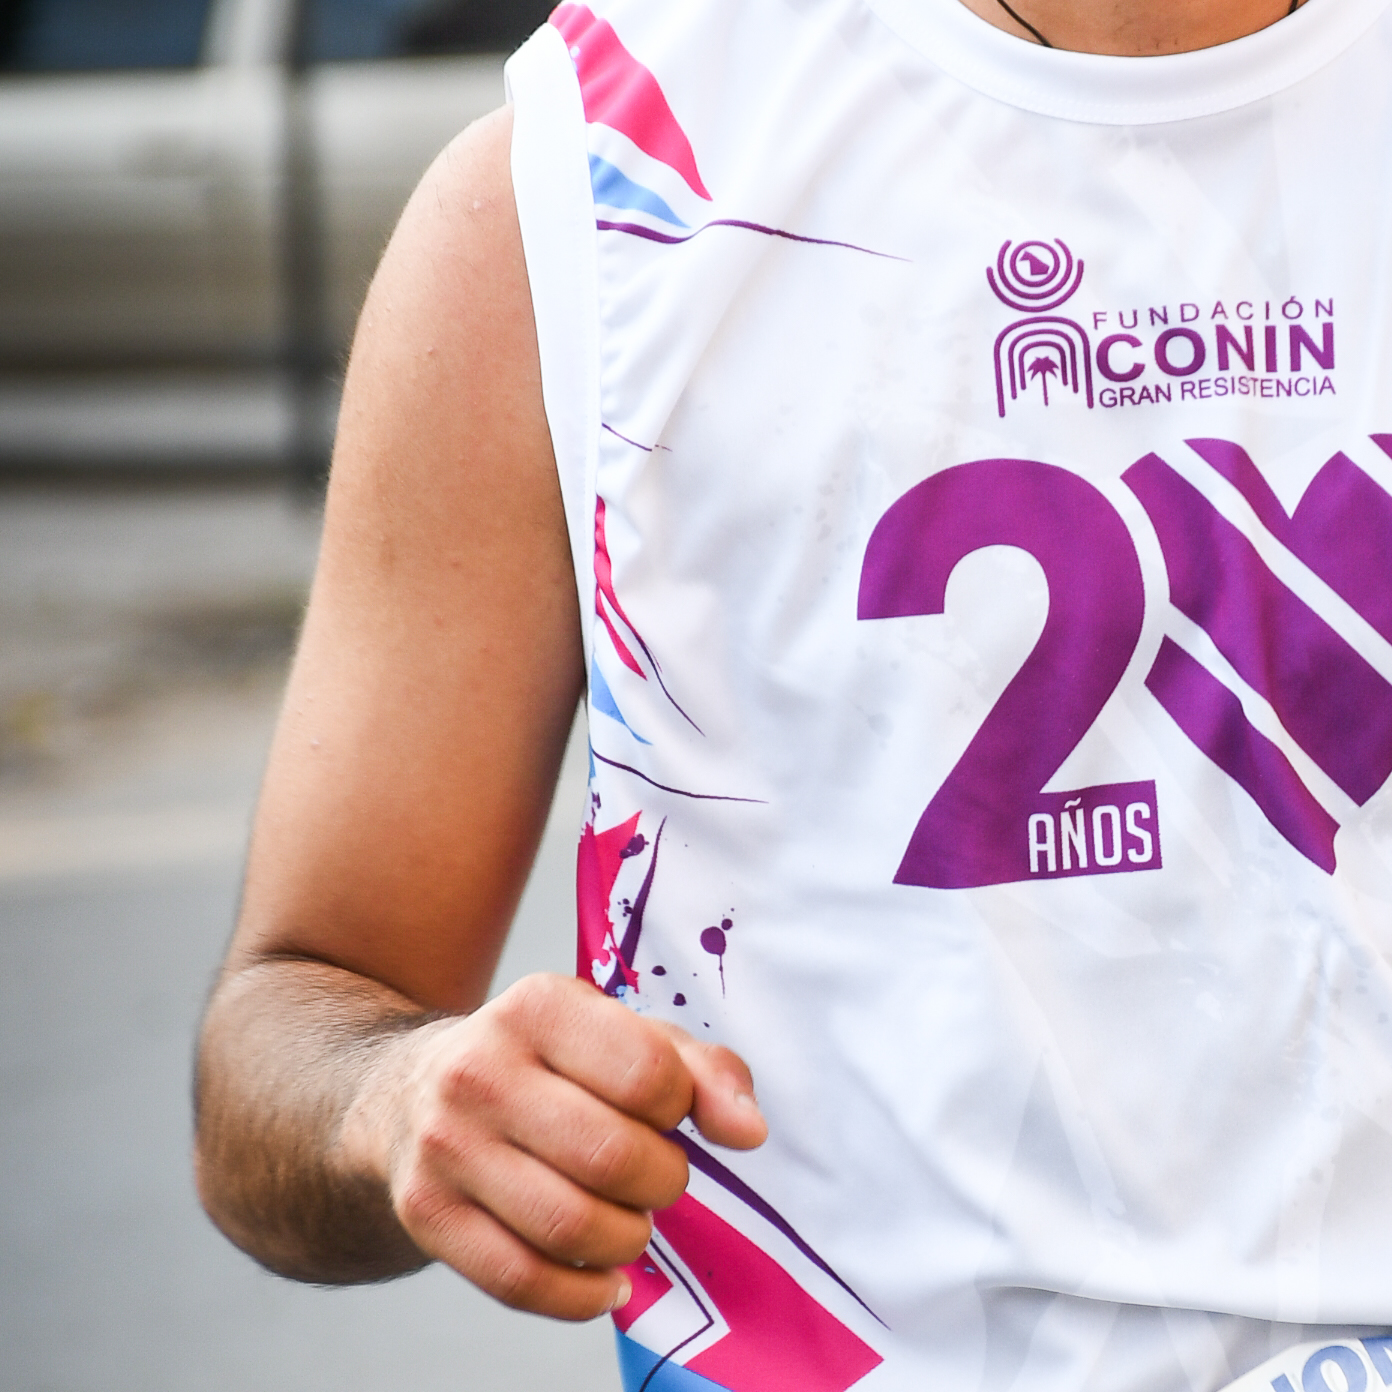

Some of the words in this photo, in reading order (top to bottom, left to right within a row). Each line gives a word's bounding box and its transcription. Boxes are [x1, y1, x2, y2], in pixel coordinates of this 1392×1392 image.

[1093, 296, 1334, 330] FUNDACIÓN
[1096, 322, 1335, 382] CONIN
[1099, 383, 1172, 408] GRAN
[1181, 375, 1336, 402] RESISTENCIA
[1028, 797, 1154, 873] AÑOS
